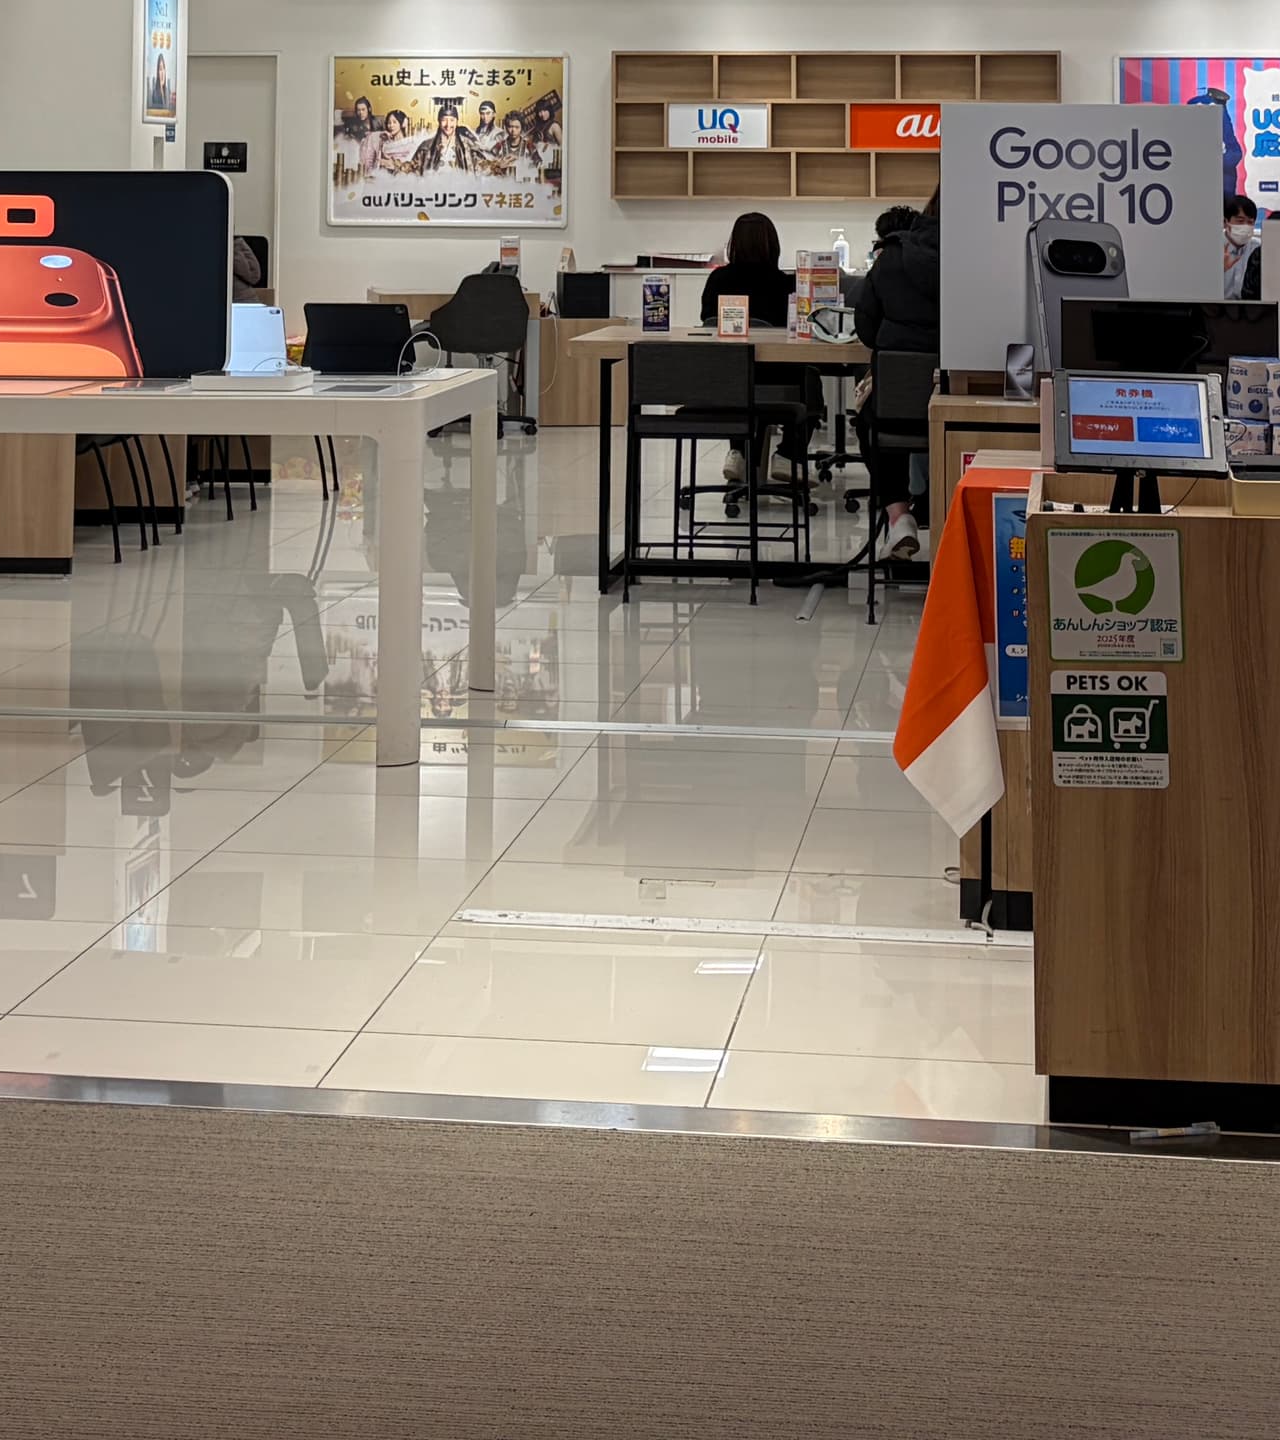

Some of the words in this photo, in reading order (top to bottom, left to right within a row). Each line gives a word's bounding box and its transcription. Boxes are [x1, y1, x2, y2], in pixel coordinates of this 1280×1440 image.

[697, 108, 742, 134] UQ
[697, 133, 739, 145] mobile
[989, 126, 1173, 182] Google
[361, 192, 477, 209] auバリューリンク
[996, 180, 1107, 224] Pixel
[1118, 183, 1173, 226] 10
[1052, 617, 1179, 633] あんしんショップ認定
[1065, 674, 1110, 691] PETS
[1117, 675, 1149, 692] OK
